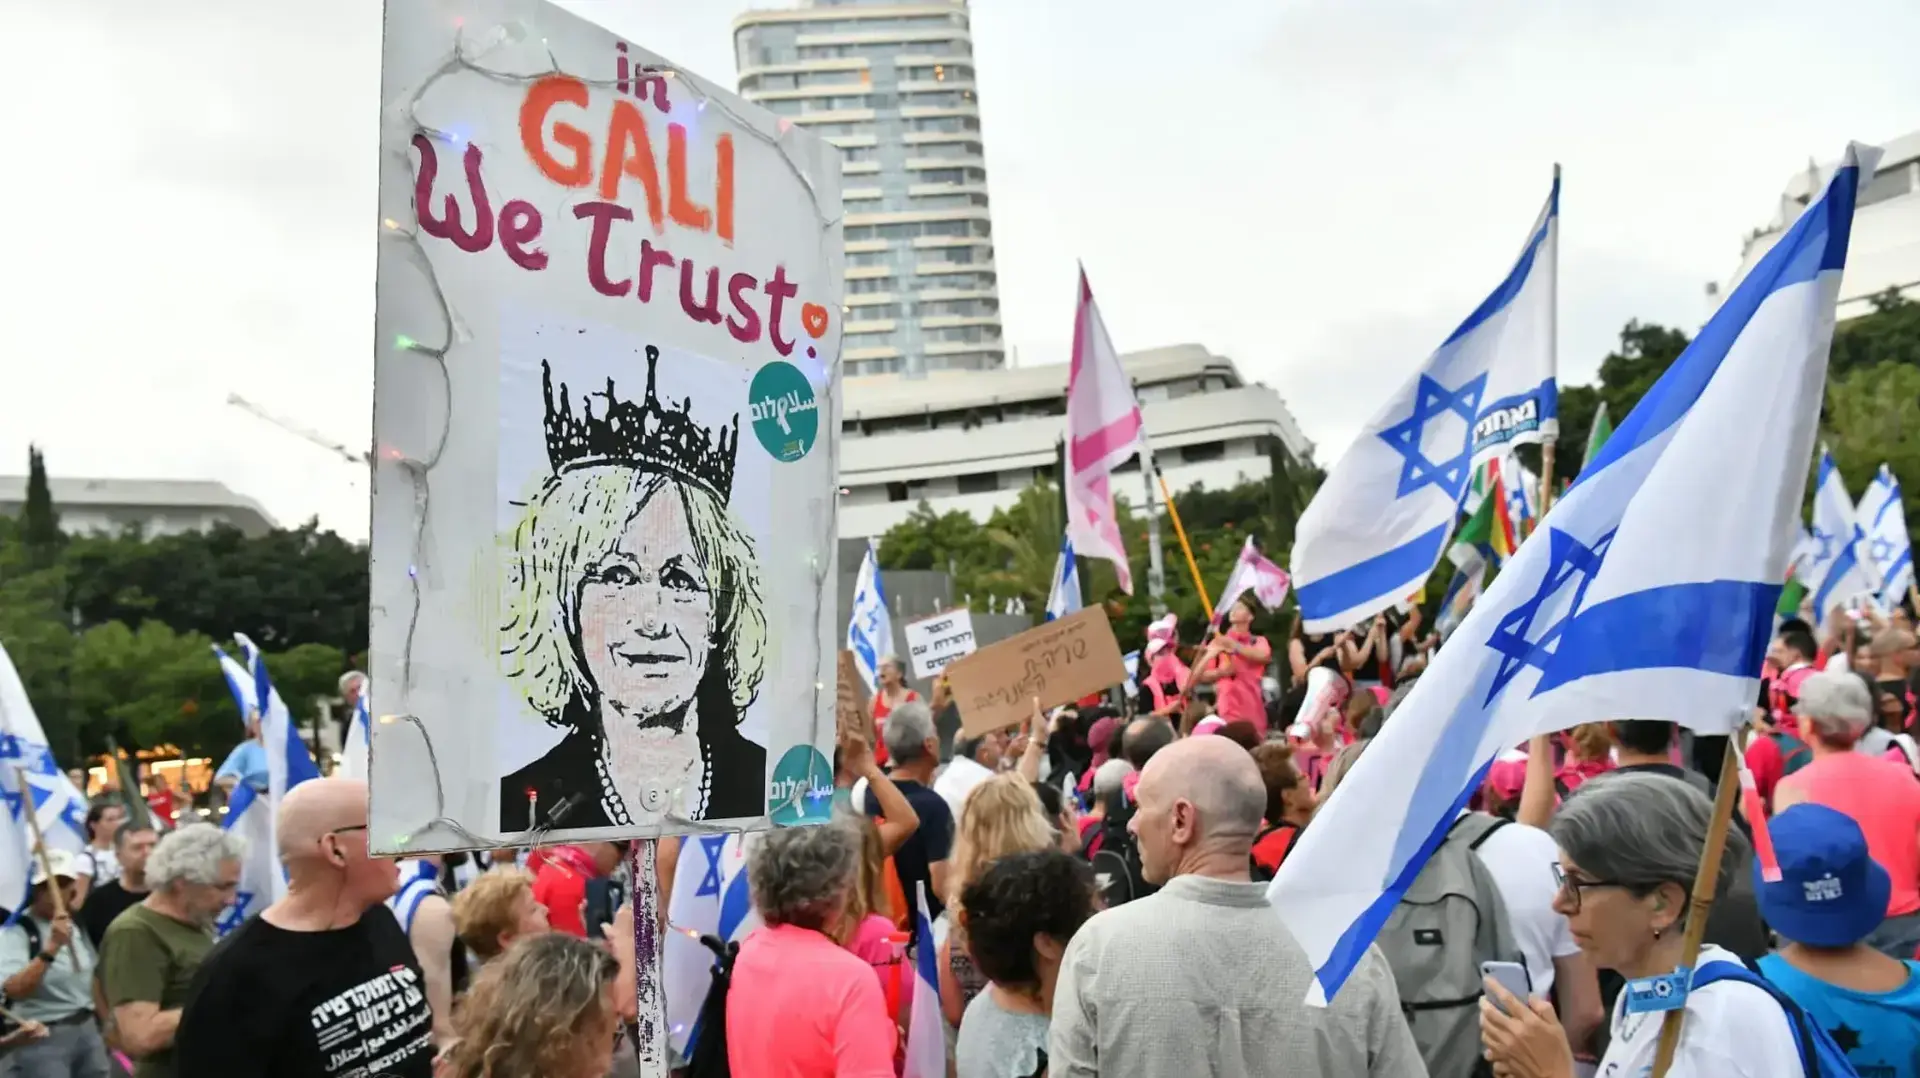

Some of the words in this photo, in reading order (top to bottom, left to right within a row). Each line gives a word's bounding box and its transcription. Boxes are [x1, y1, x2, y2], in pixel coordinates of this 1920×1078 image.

[614, 41, 671, 113] in
[411, 133, 549, 271] We
[518, 72, 735, 249] GALI
